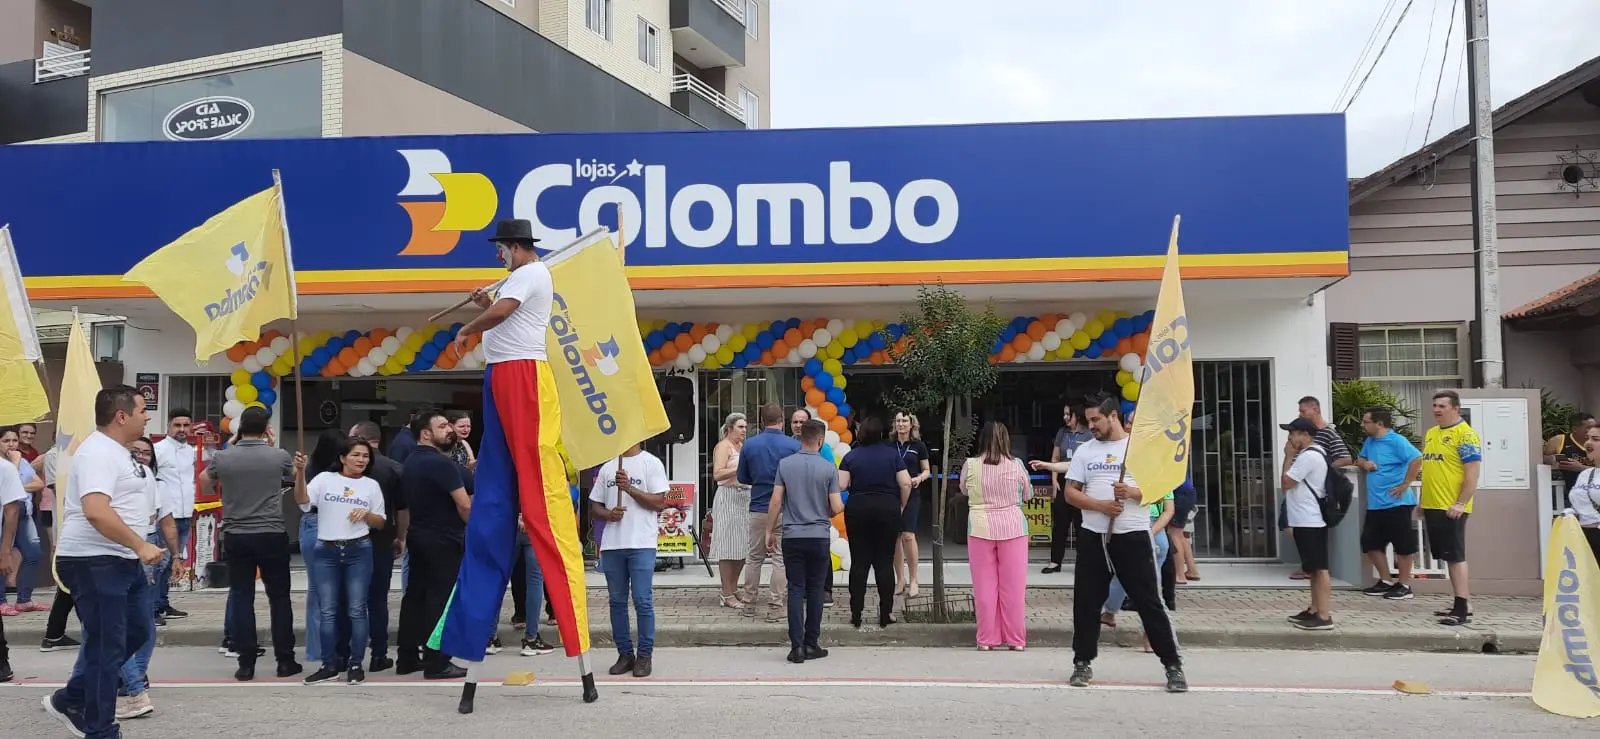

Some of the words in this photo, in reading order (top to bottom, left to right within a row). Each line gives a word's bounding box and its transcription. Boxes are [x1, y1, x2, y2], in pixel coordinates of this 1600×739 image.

[195, 102, 220, 116] CIA
[175, 118, 209, 134] SPORT
[210, 113, 242, 129] BASIC
[575, 158, 616, 181] lojas
[513, 161, 959, 250] Colombo
[1087, 462, 1120, 472] Colom
[606, 477, 642, 488] Cobo
[324, 493, 369, 507] Colombo
